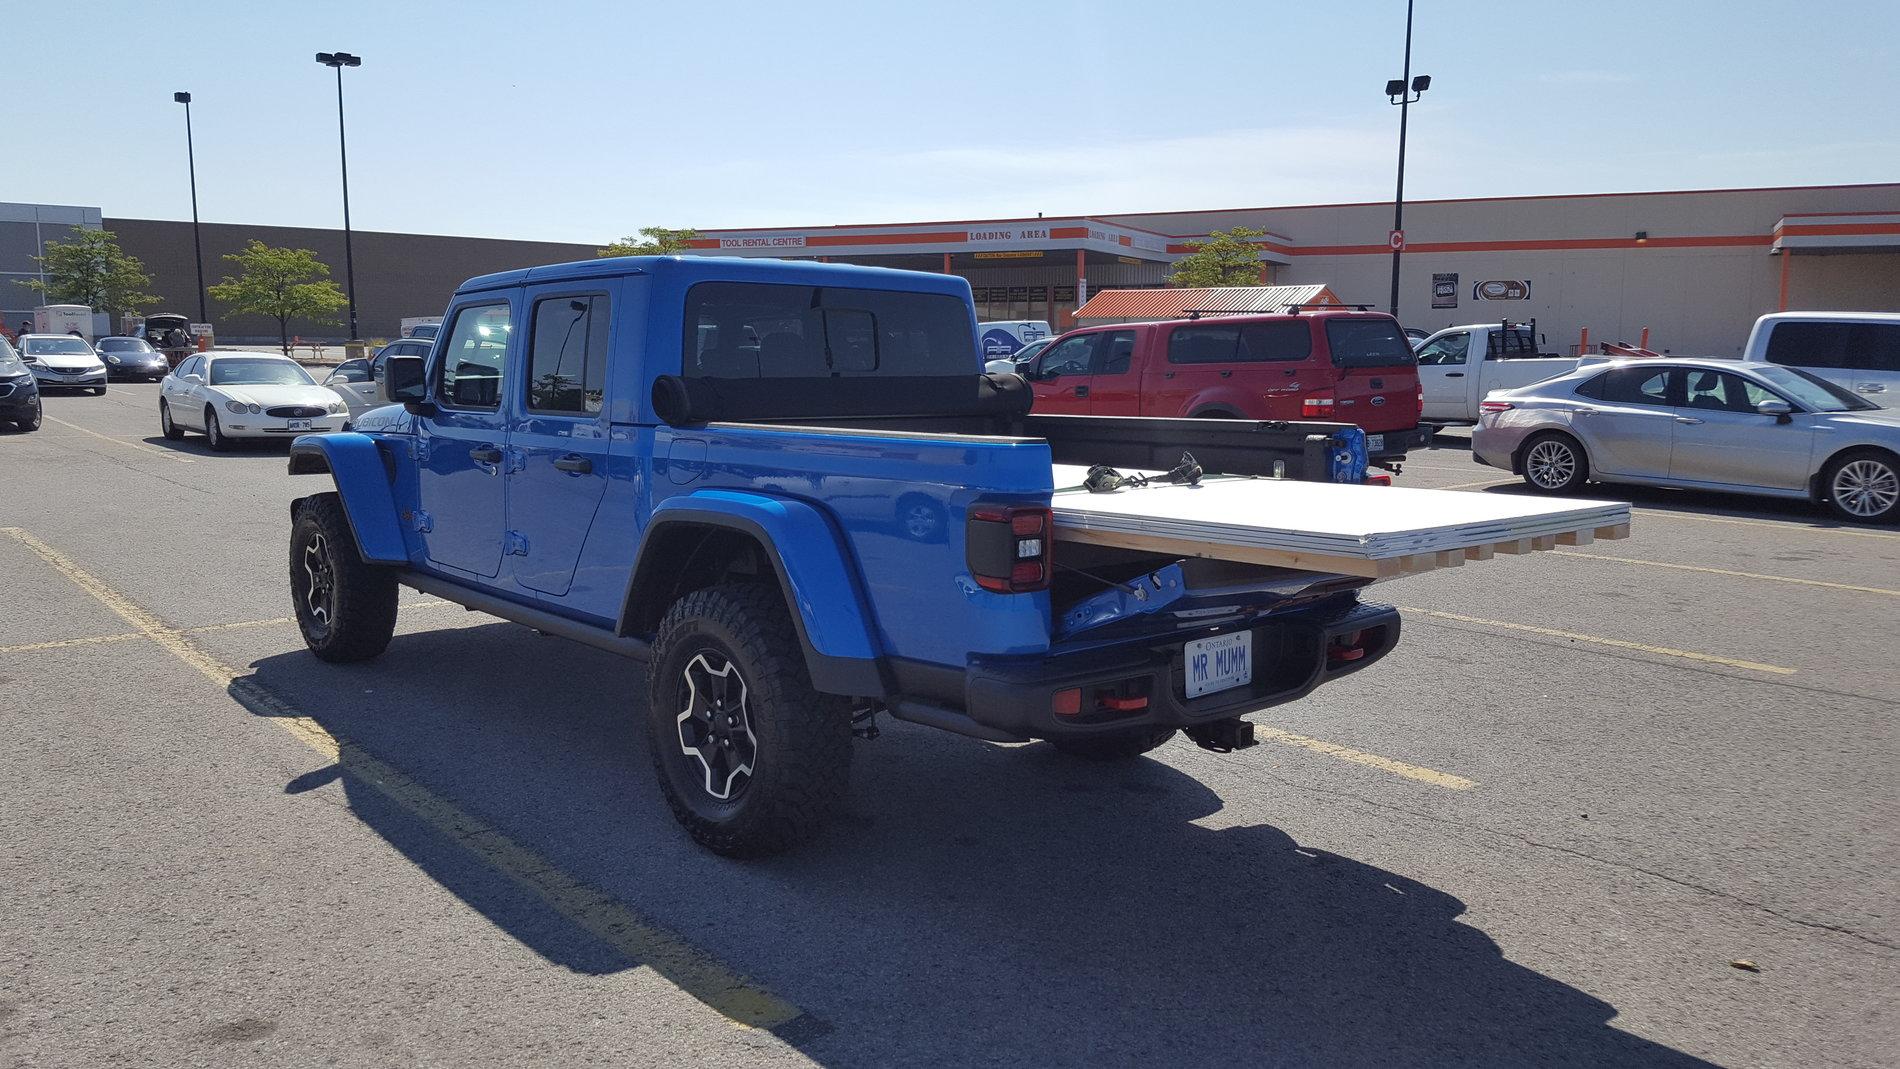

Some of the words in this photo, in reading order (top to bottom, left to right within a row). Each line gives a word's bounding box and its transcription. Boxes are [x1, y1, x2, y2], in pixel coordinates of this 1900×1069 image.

[970, 231, 1011, 240] LOADING
[1020, 230, 1046, 239] AREA
[1391, 232, 1402, 248] C
[721, 239, 741, 247] TOOL
[743, 238, 770, 247] RENTAL
[773, 237, 802, 246] CENTRE
[1206, 639, 1233, 651] ONTARIO
[1193, 653, 1208, 683] MR
[1216, 645, 1246, 678] MUMM
